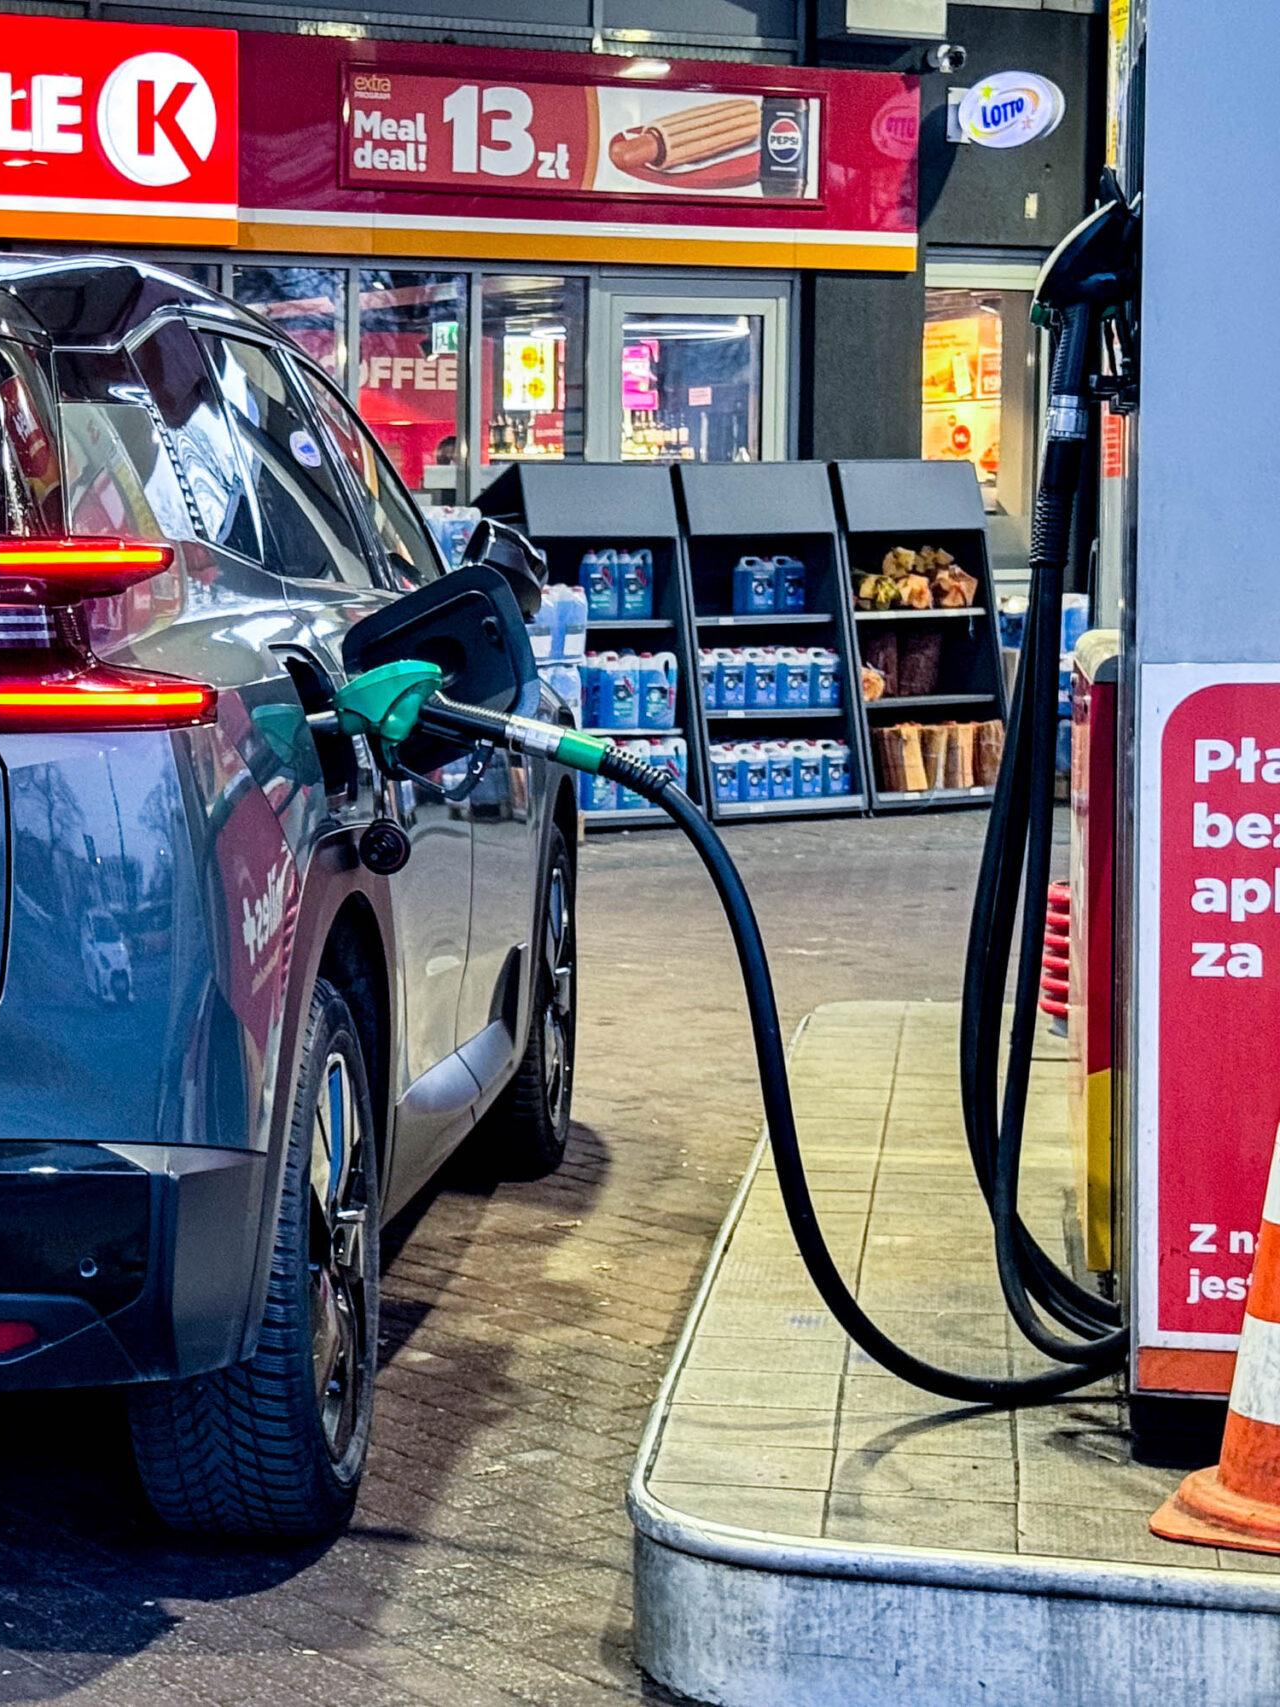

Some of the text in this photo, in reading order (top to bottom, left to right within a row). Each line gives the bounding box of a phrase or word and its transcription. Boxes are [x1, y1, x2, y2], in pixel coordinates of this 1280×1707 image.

[354, 75, 391, 93] extra
[136, 79, 207, 177] K
[353, 109, 428, 143] Meal
[982, 97, 1024, 129] LOTTO
[443, 85, 570, 180] 13 zł
[770, 135, 799, 146] PEPSI
[353, 139, 428, 173] deal!
[1193, 801, 1280, 849] be
[1190, 867, 1280, 922] ap
[1190, 942, 1263, 978] za
[1189, 1223, 1261, 1254] Z n
